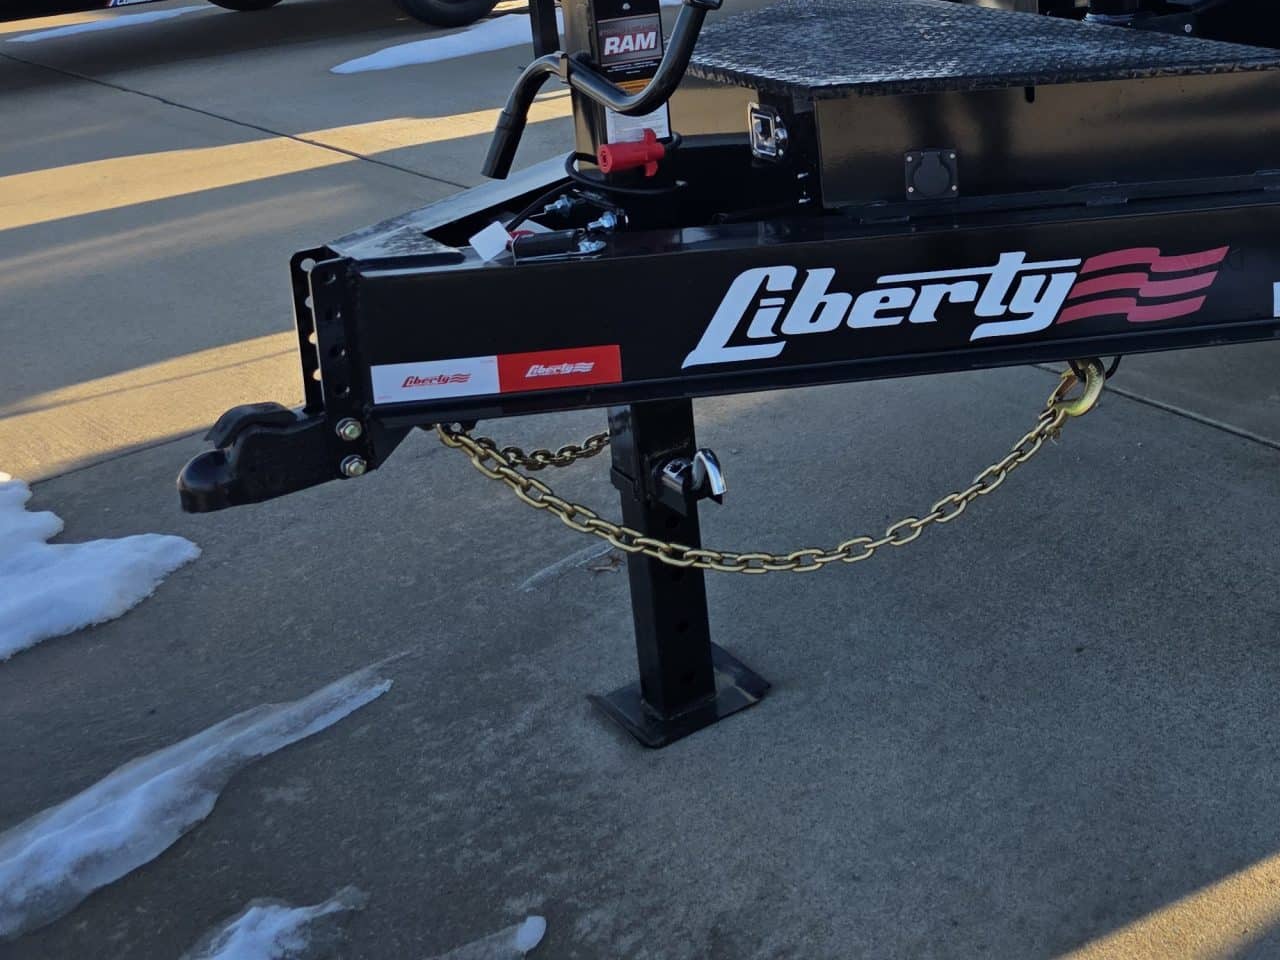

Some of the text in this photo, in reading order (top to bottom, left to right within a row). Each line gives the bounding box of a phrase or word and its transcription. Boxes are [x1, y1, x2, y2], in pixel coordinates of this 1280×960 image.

[604, 32, 657, 55] RAM
[681, 251, 1082, 369] Liberty
[402, 363, 573, 388] Liberty Liberty
